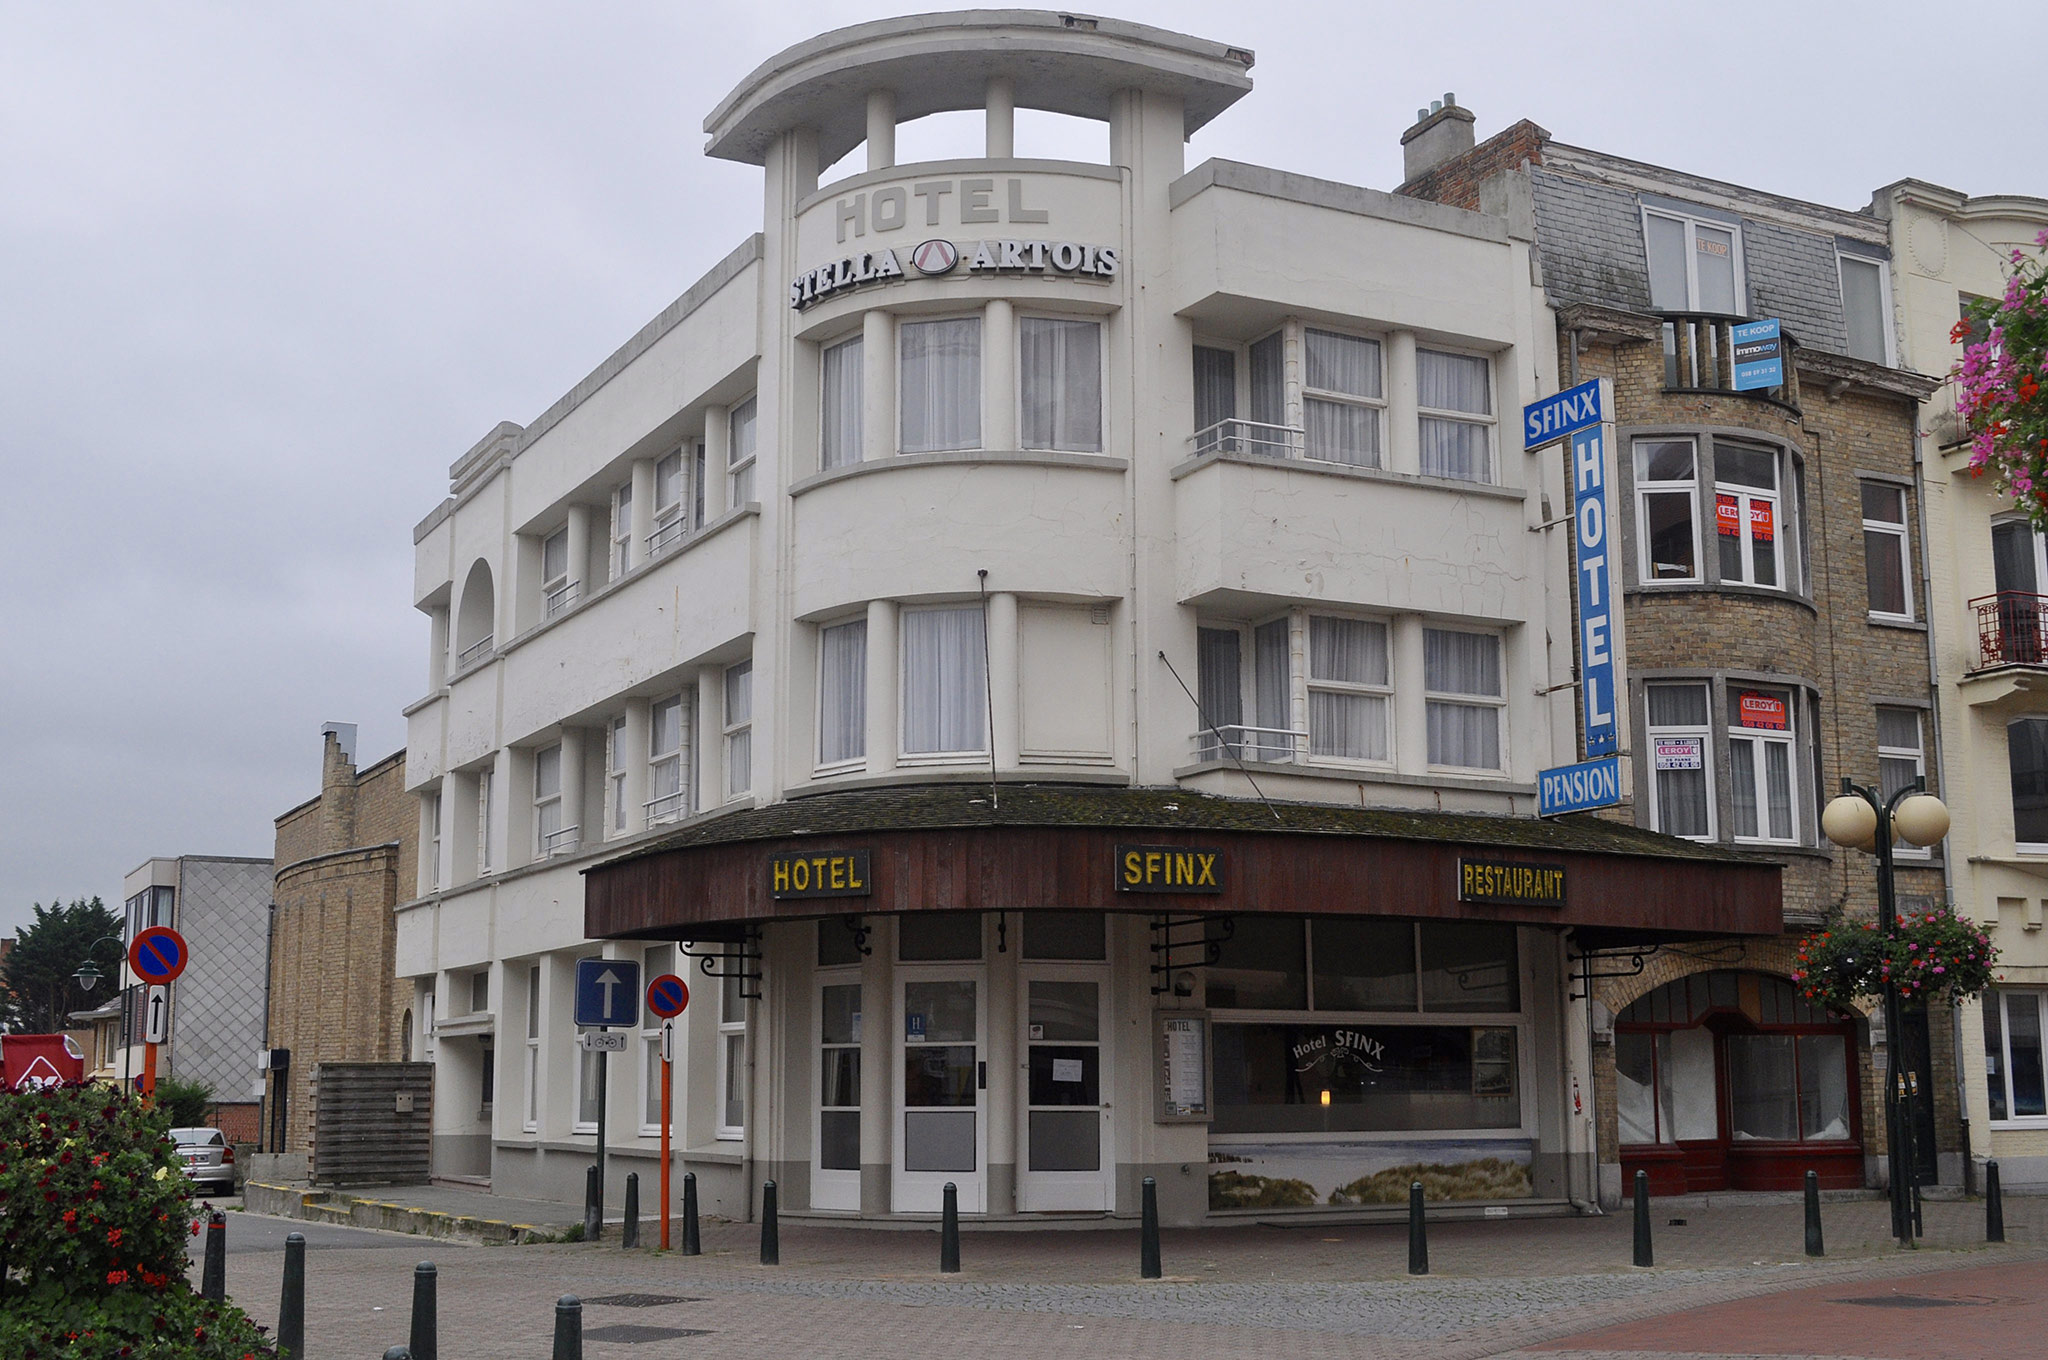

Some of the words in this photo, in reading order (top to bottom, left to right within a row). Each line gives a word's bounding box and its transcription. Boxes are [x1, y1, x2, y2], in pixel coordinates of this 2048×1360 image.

[837, 179, 1048, 243] HOTEL
[790, 248, 903, 309] STELLA
[969, 239, 1121, 277] ARTOIS
[1750, 324, 1775, 335] KOOP
[1736, 342, 1777, 356] immoway
[1529, 388, 1598, 439] SFINX
[1577, 438, 1611, 727] HOTEL
[1744, 700, 1773, 710] LEROY
[1544, 765, 1616, 814] PENSION
[773, 856, 863, 892] HOTEL
[1124, 851, 1217, 886] SFINX
[1464, 864, 1563, 900] RESTAURANT
[1167, 1021, 1191, 1032] HOTEL
[1292, 1035, 1327, 1059] Hotel
[1335, 1029, 1385, 1061] SFINX
